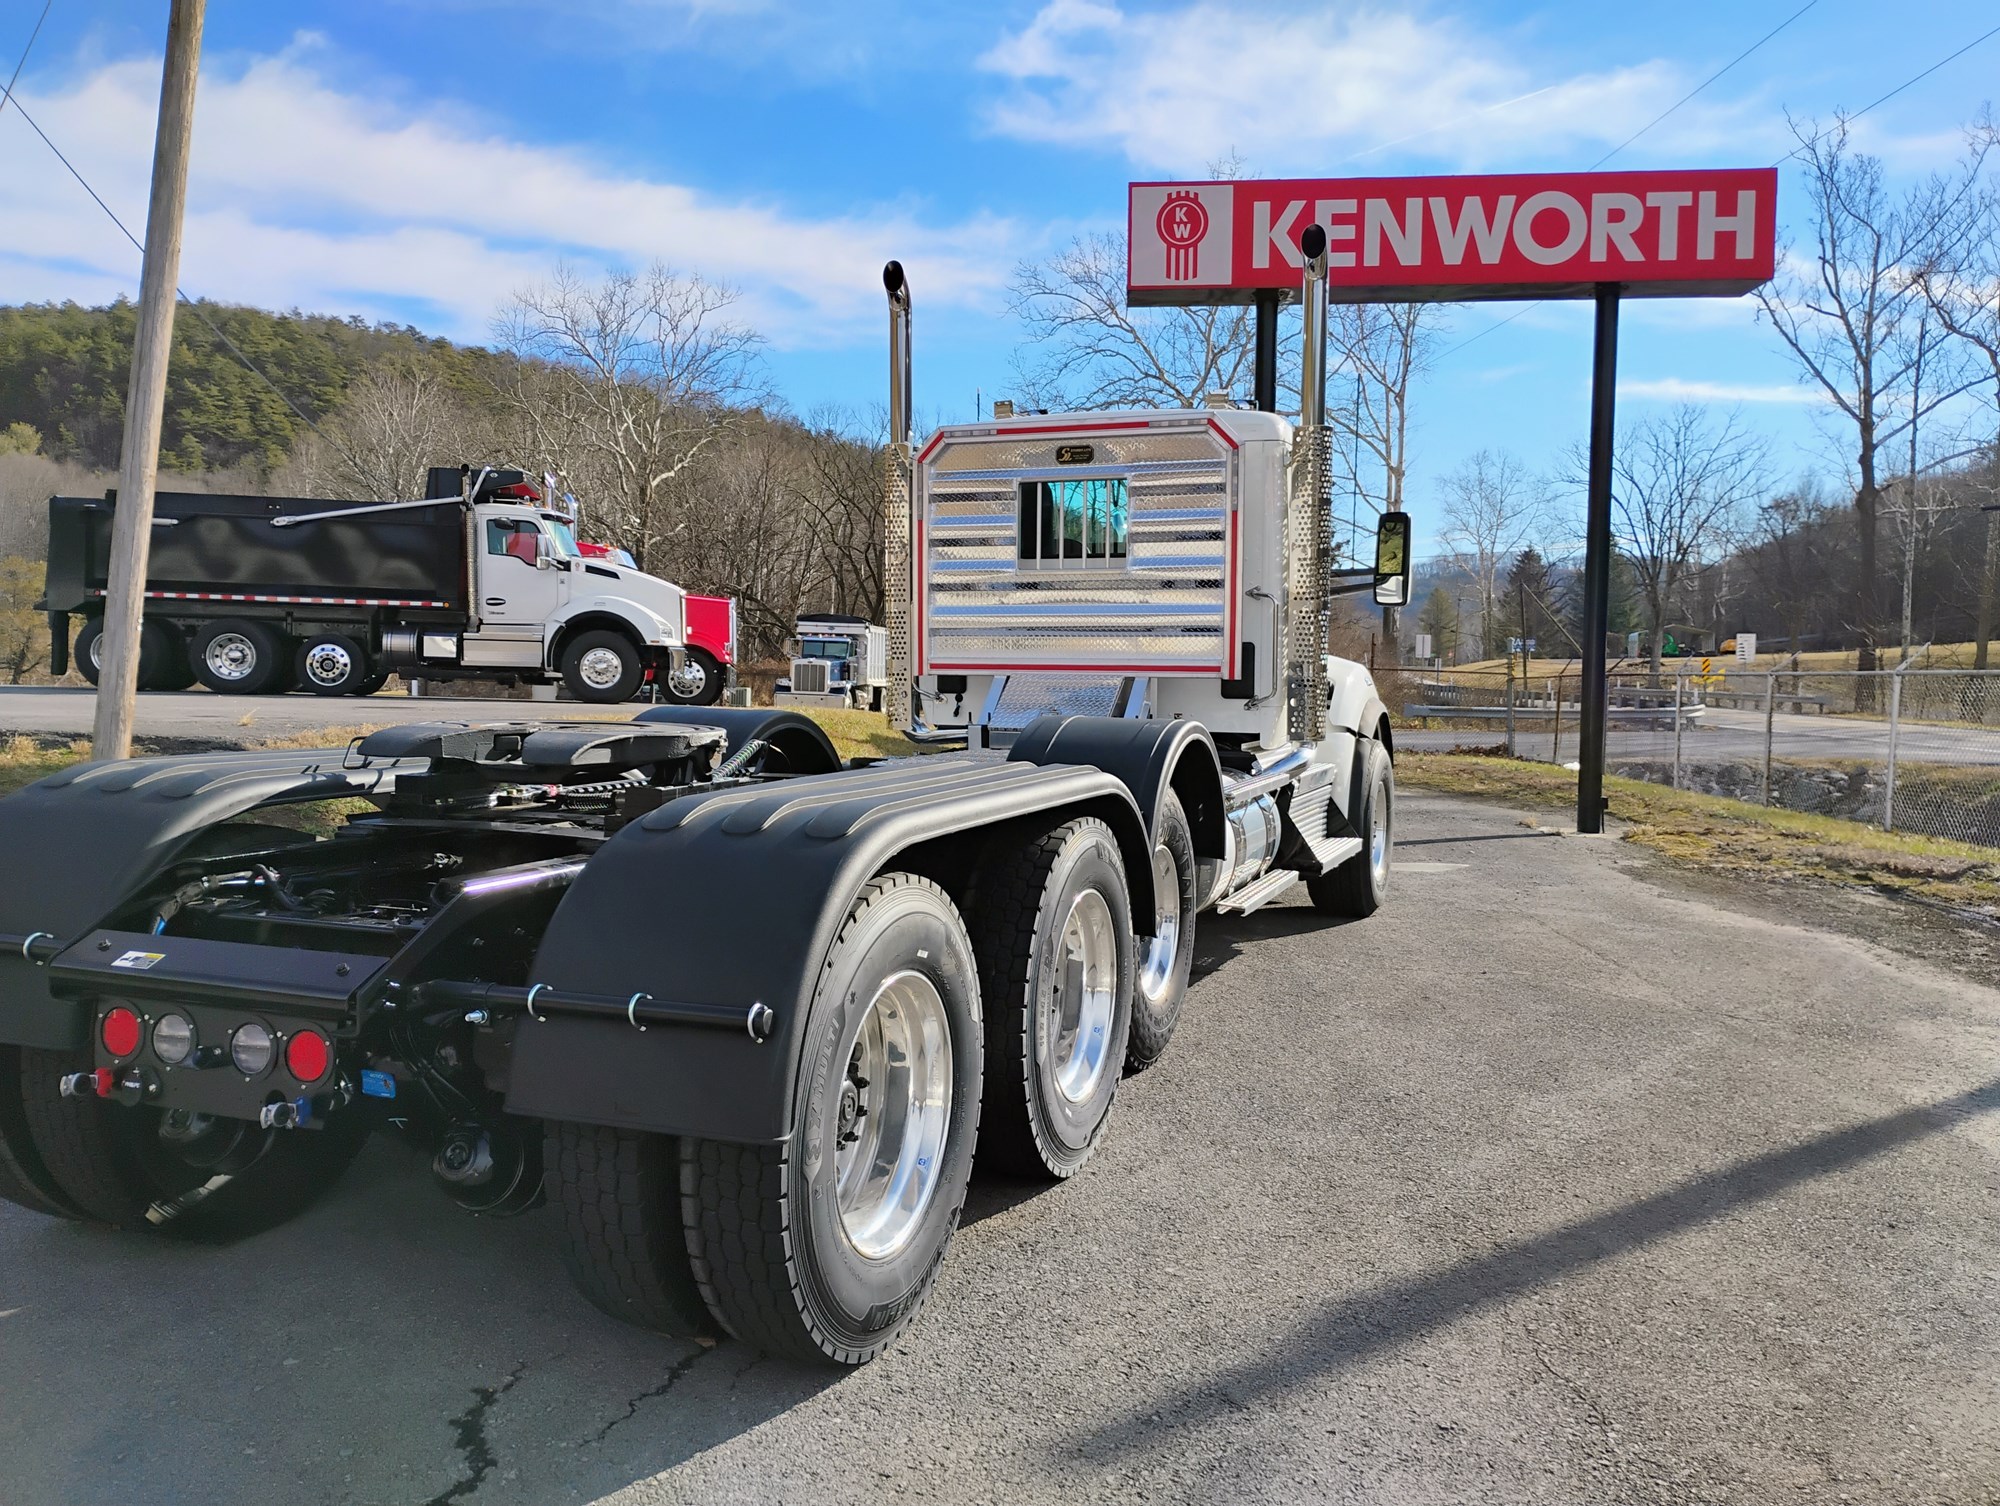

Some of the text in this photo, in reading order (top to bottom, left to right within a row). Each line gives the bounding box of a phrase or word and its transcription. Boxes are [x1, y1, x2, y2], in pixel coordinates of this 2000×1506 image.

[1173, 223, 1191, 239] W
[1175, 207, 1188, 222] K
[1252, 187, 1756, 269] KENWORTH
[814, 1017, 840, 1099] MULTI
